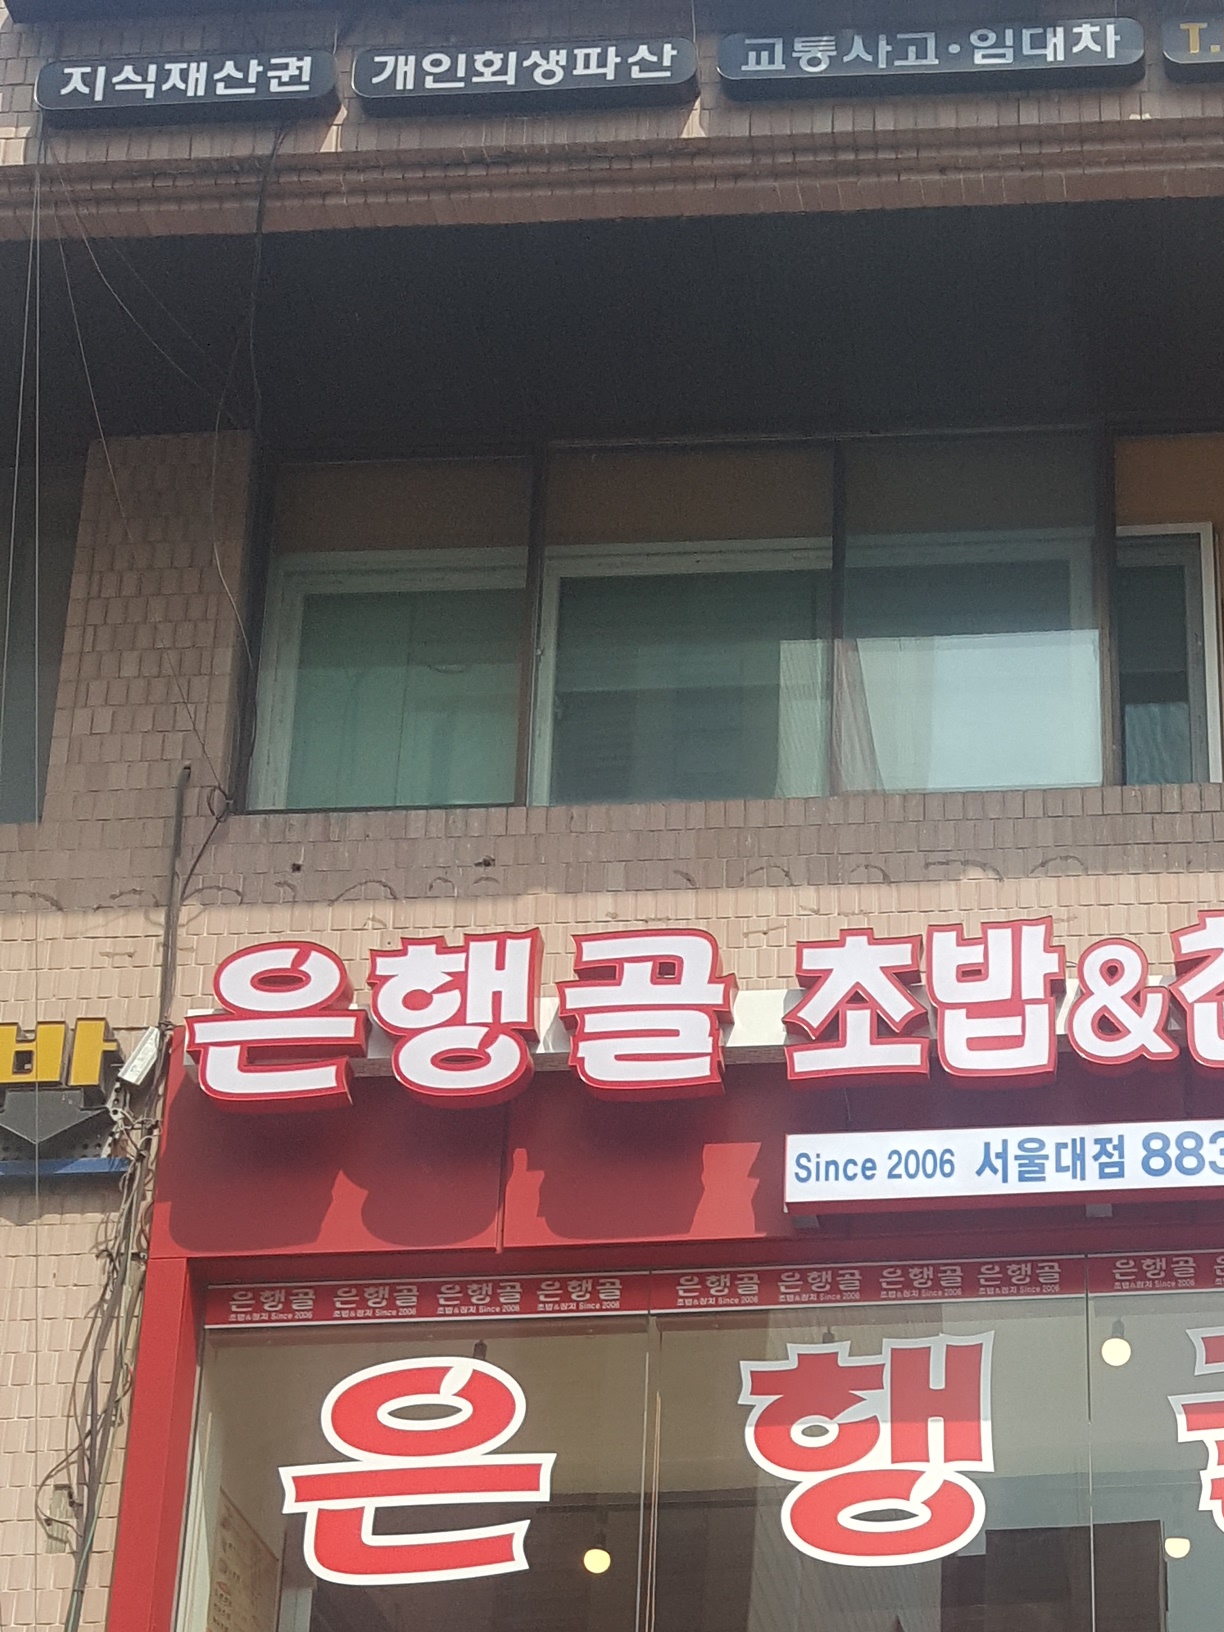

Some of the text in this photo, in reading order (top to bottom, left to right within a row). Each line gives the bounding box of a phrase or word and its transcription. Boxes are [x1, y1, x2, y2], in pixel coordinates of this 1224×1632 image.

[60, 54, 313, 101] 지식재산권
[371, 42, 679, 91] 개인회생파산
[187, 927, 737, 1105] 은행골
[793, 1150, 878, 1184] Since
[886, 1146, 956, 1181] 2006
[975, 1133, 1127, 1186] 서울대점
[880, 1265, 964, 1288] 은행골
[977, 1262, 1061, 1285] 은행골
[1113, 1256, 1196, 1279] 은행골
[537, 1279, 622, 1302] 은행골
[676, 1273, 760, 1296] 은행골
[778, 1270, 862, 1292] 은행골
[1155, 1280, 1175, 1288] Since
[229, 1288, 315, 1311] 은행골
[333, 1285, 419, 1309] 은행골
[437, 1282, 522, 1304] 은행골
[375, 1309, 396, 1317] Since
